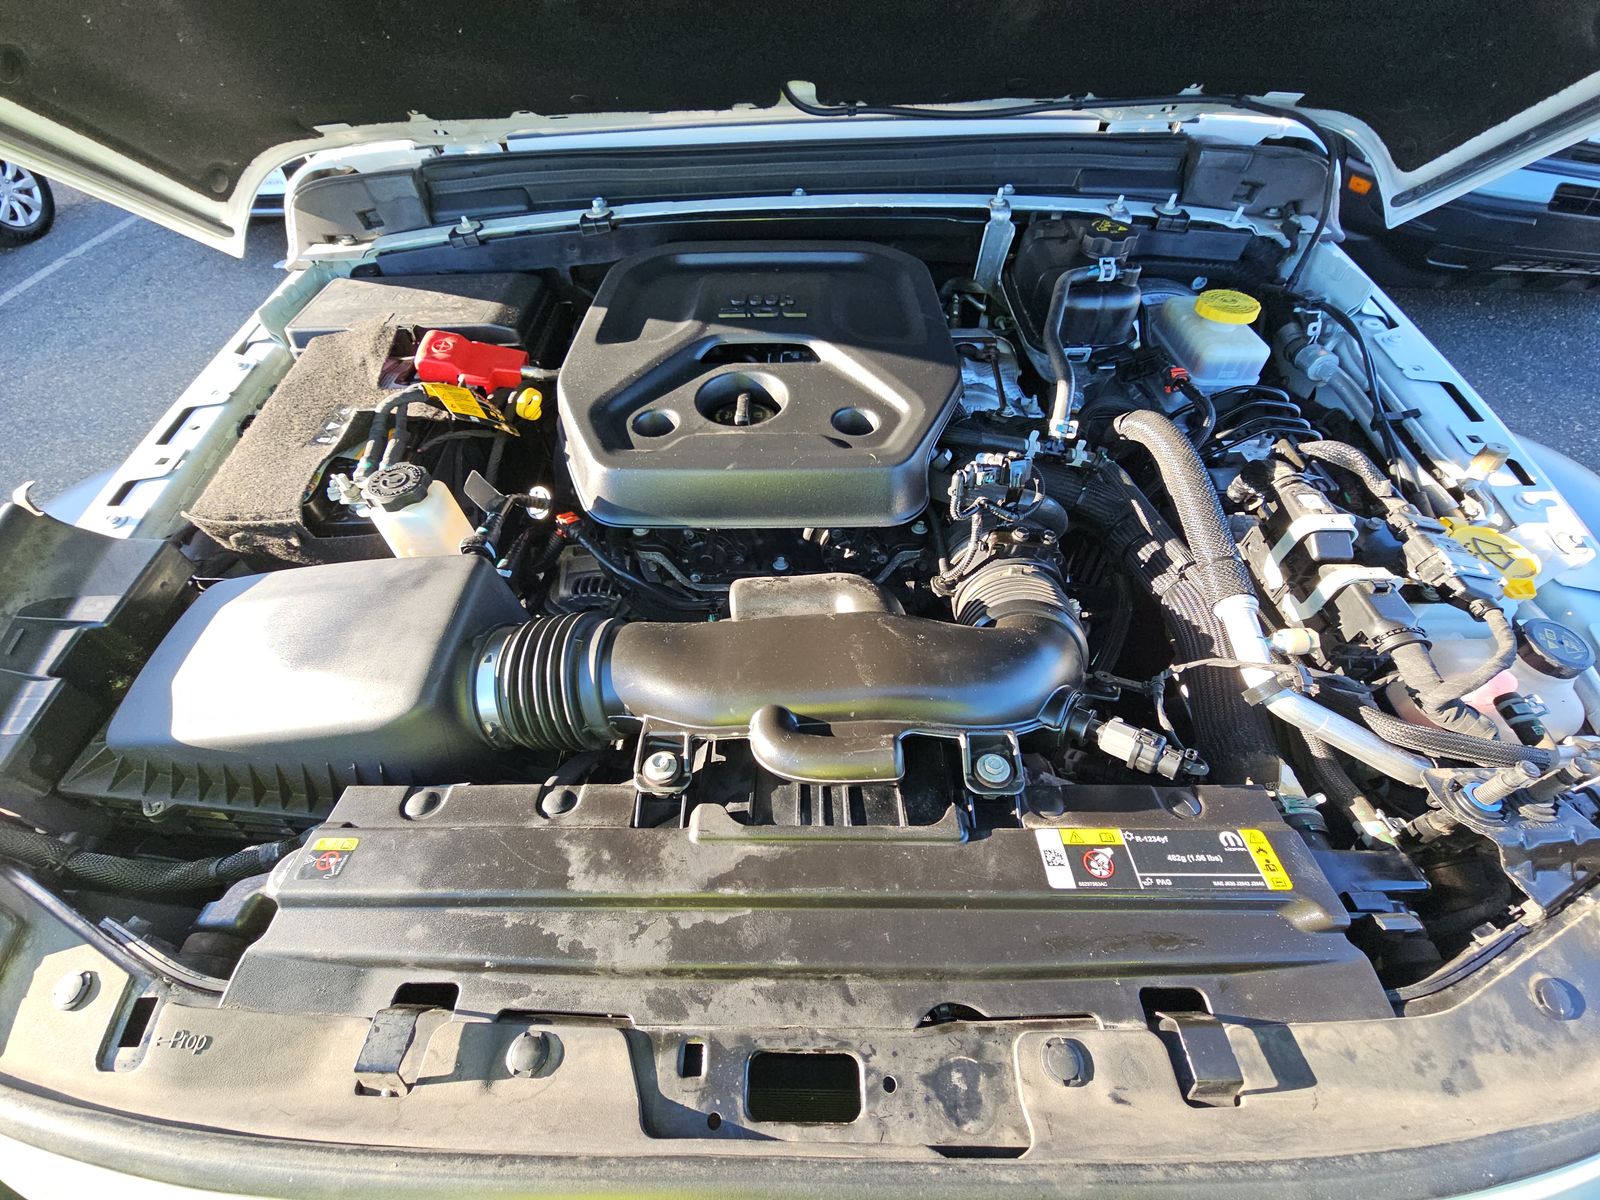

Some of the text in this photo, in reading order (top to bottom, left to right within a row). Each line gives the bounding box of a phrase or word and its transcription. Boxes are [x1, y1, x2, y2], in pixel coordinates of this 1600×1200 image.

[1207, 854, 1223, 863] lbs)
[1156, 878, 1173, 886] PAG
[169, 1029, 210, 1056] Prop
